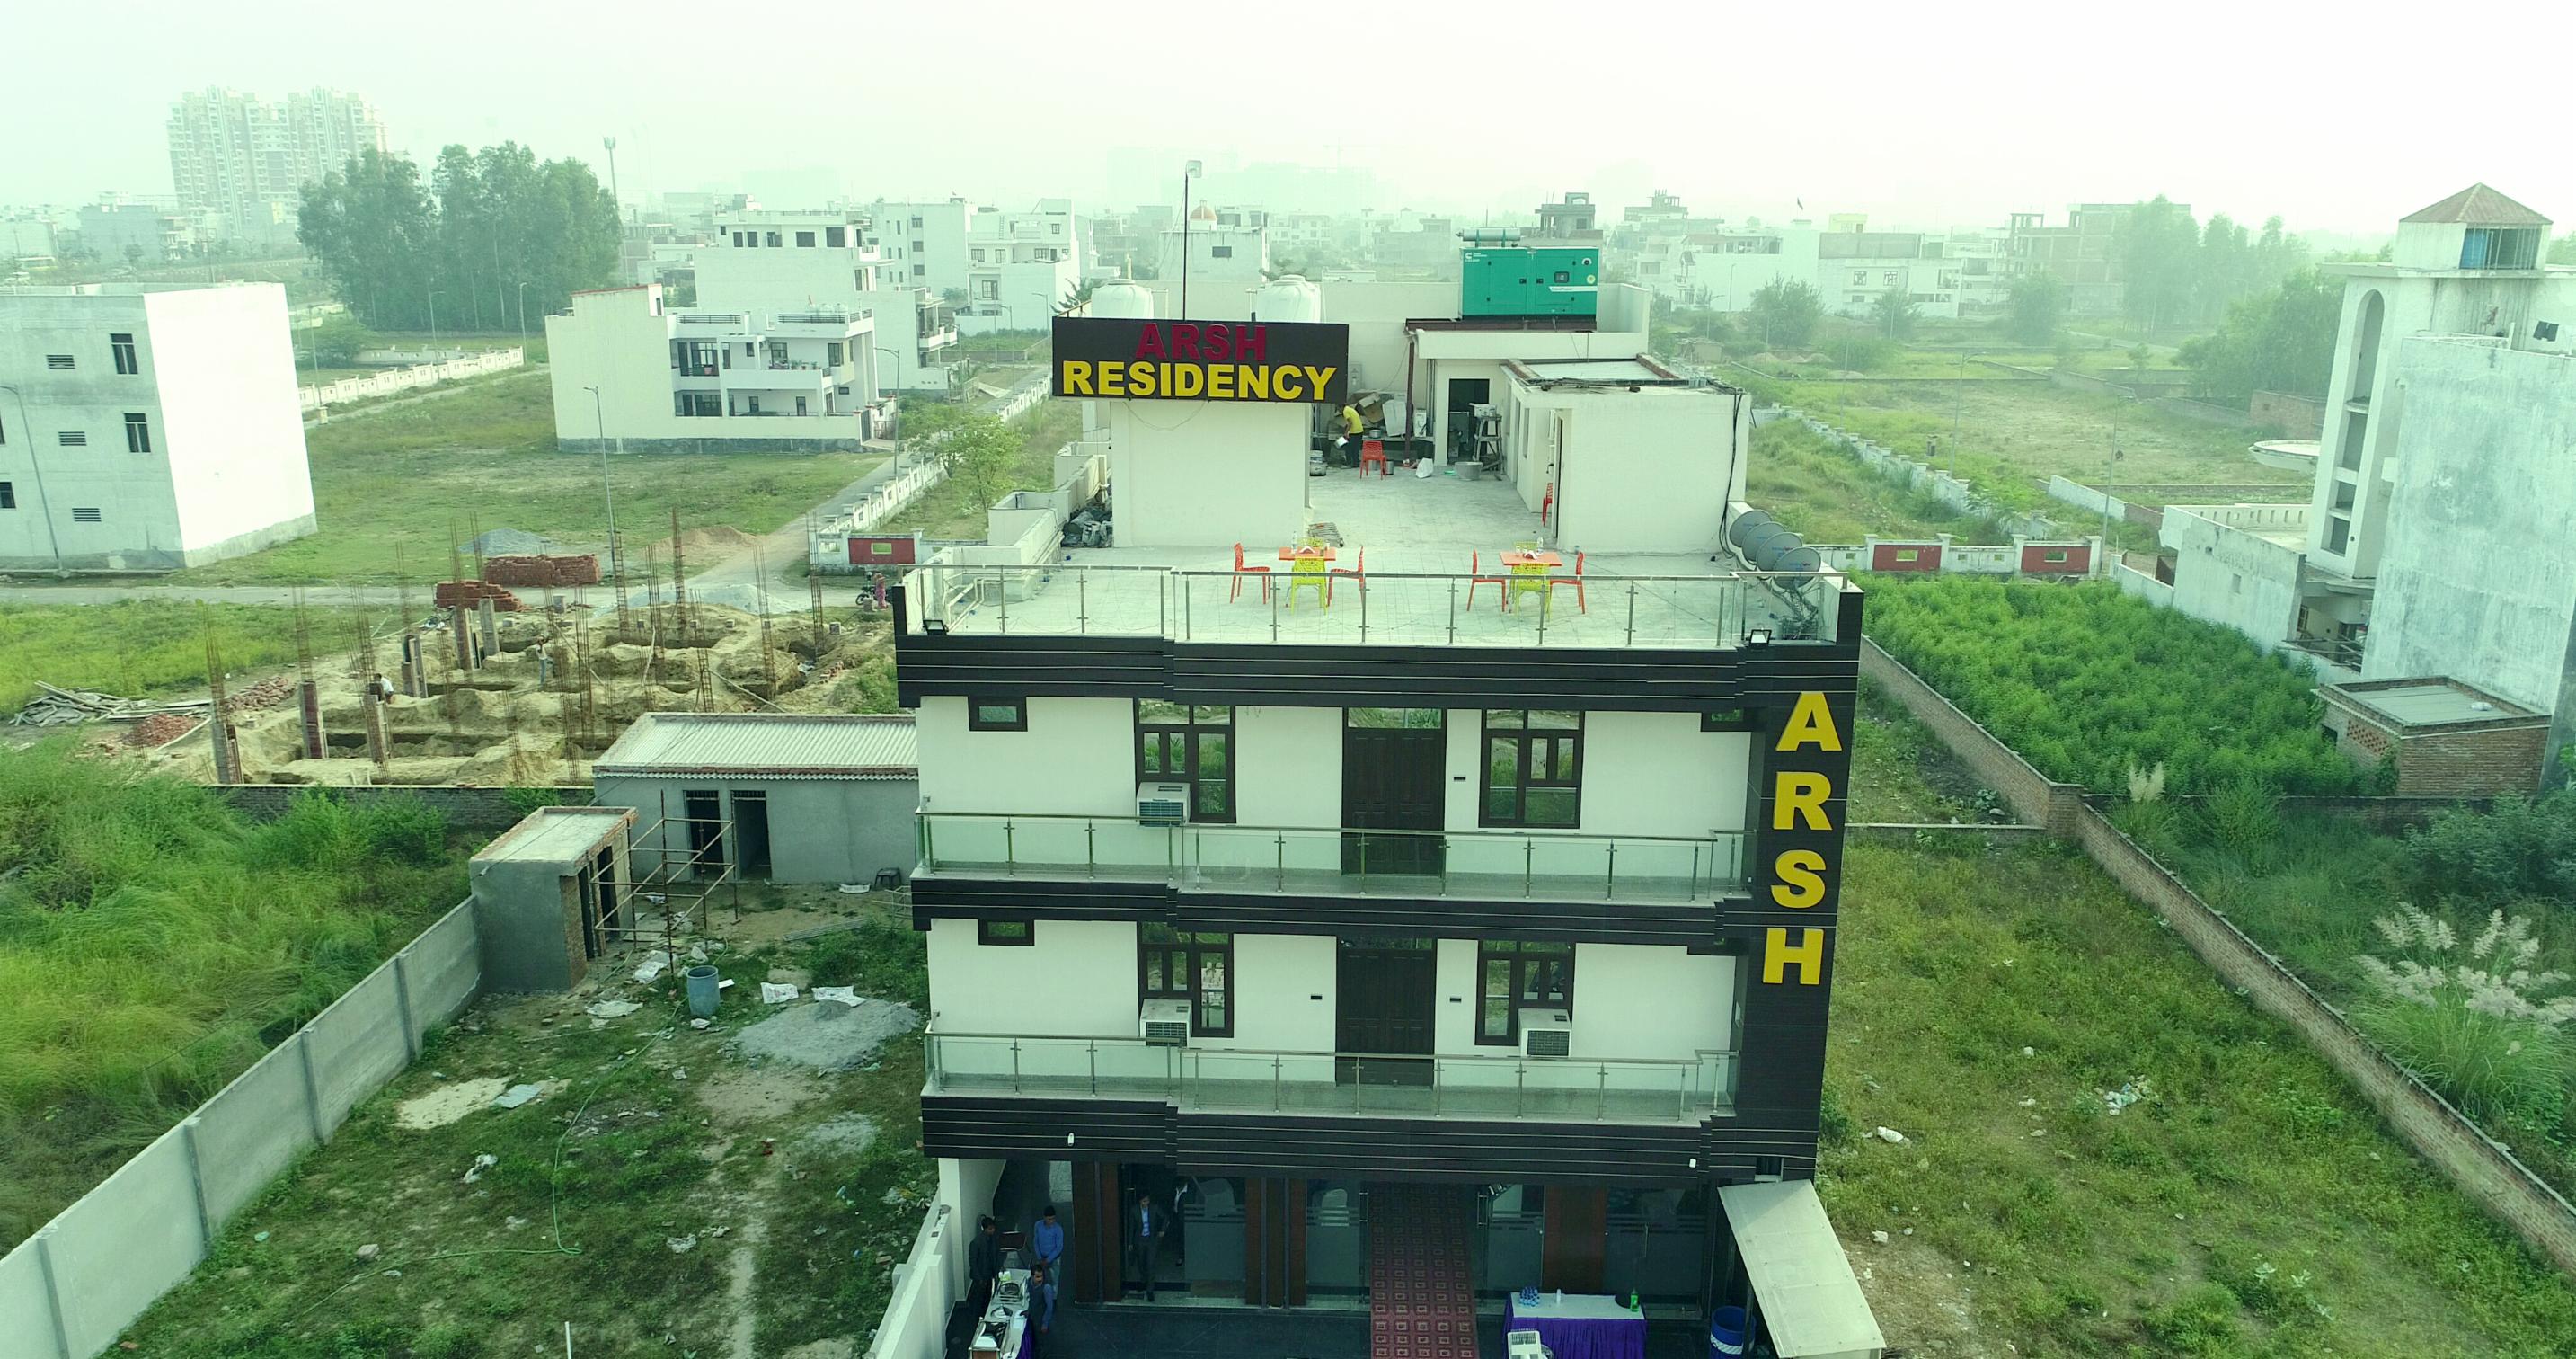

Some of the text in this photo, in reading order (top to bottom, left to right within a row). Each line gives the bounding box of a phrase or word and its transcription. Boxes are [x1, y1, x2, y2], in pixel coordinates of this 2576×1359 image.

[1135, 323, 1267, 361] ARSH
[1062, 360, 1337, 401] RESIDENCY
[1762, 691, 1843, 985] ARSH
